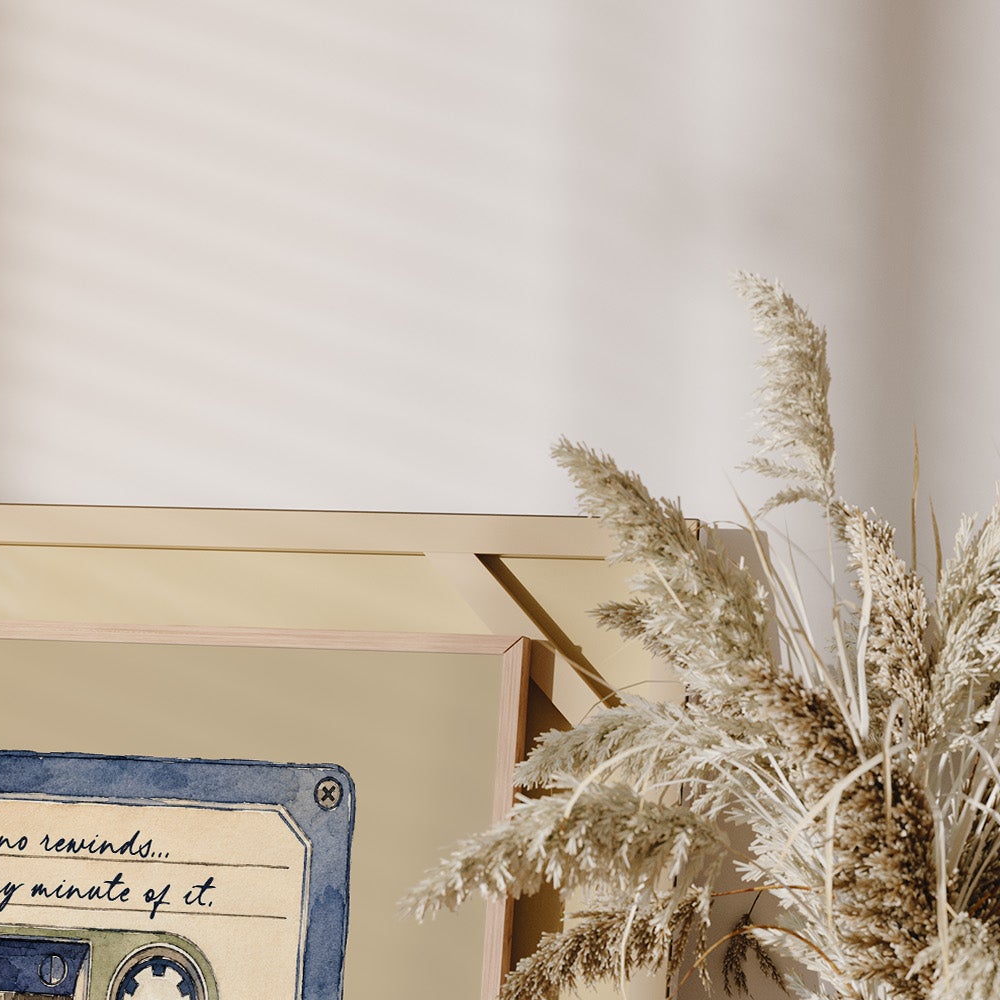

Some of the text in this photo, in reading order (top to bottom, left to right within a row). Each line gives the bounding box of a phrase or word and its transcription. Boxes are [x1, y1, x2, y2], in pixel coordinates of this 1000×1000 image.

[30, 872, 130, 904] minute
[143, 883, 171, 920] of
[182, 876, 215, 907] it.
